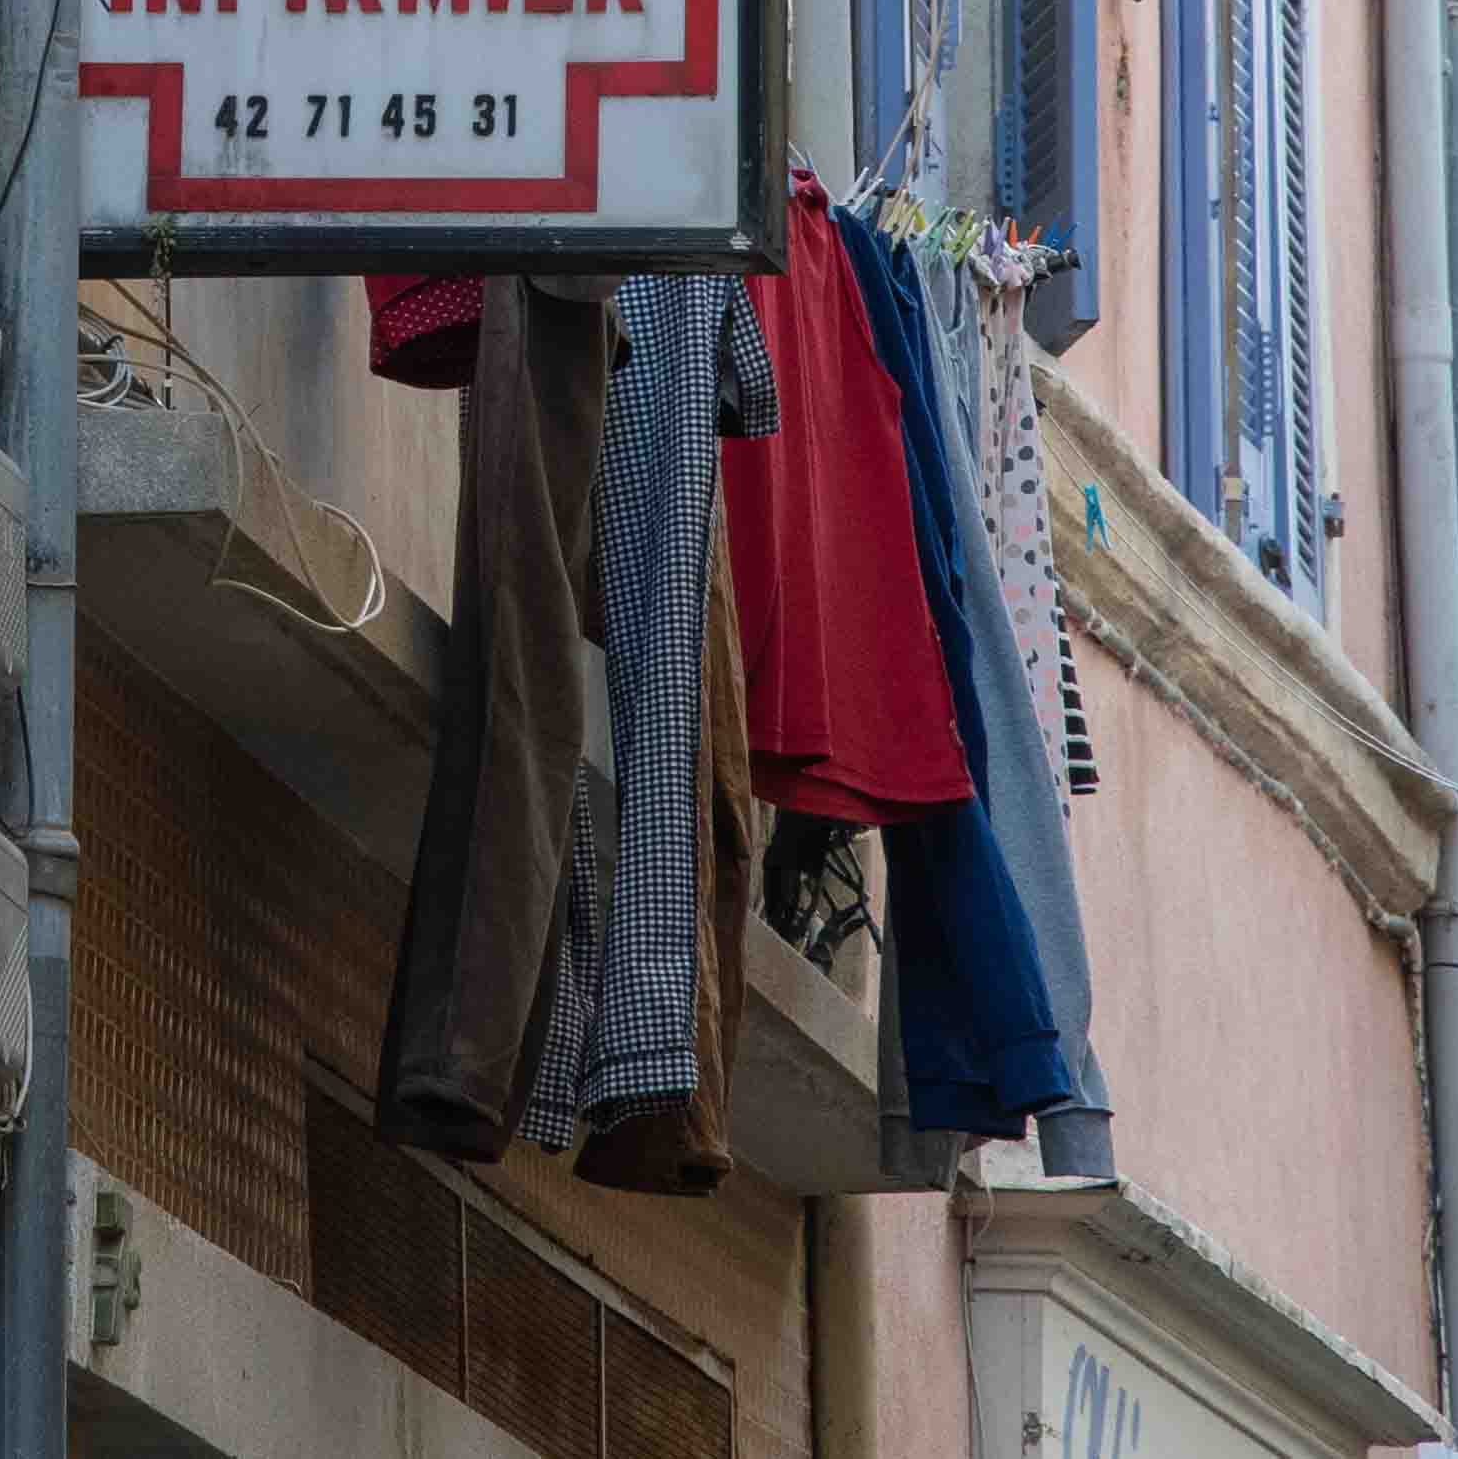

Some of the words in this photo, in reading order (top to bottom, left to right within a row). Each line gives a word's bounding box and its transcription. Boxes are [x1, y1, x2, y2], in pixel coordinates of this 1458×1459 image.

[214, 94, 270, 139] 42
[306, 94, 352, 139] 71
[381, 93, 437, 139] 45
[472, 93, 518, 138] 31
